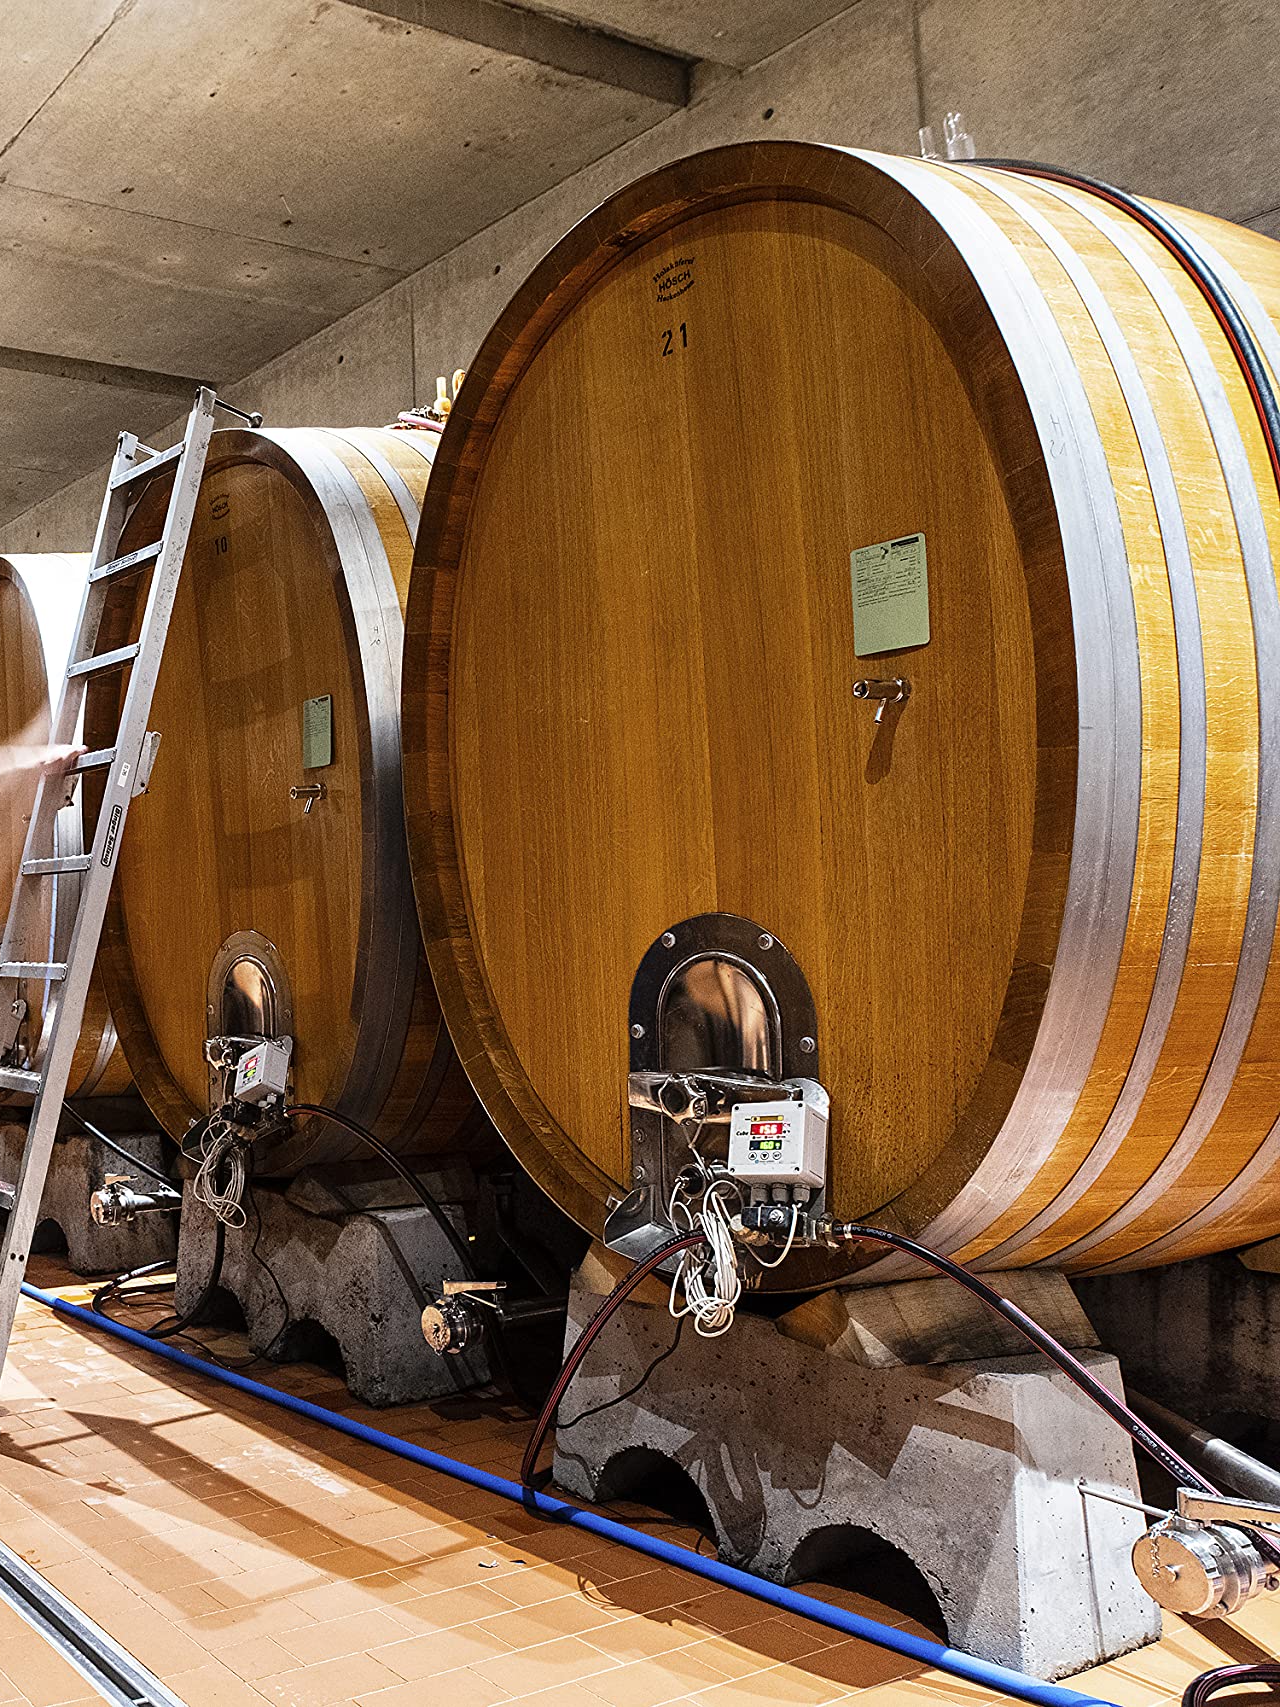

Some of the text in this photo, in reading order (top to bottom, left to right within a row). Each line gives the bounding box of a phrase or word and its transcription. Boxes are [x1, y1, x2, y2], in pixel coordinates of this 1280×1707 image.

[659, 270, 691, 292] HÖSCH
[661, 322, 687, 356] 21
[215, 536, 228, 555] 10
